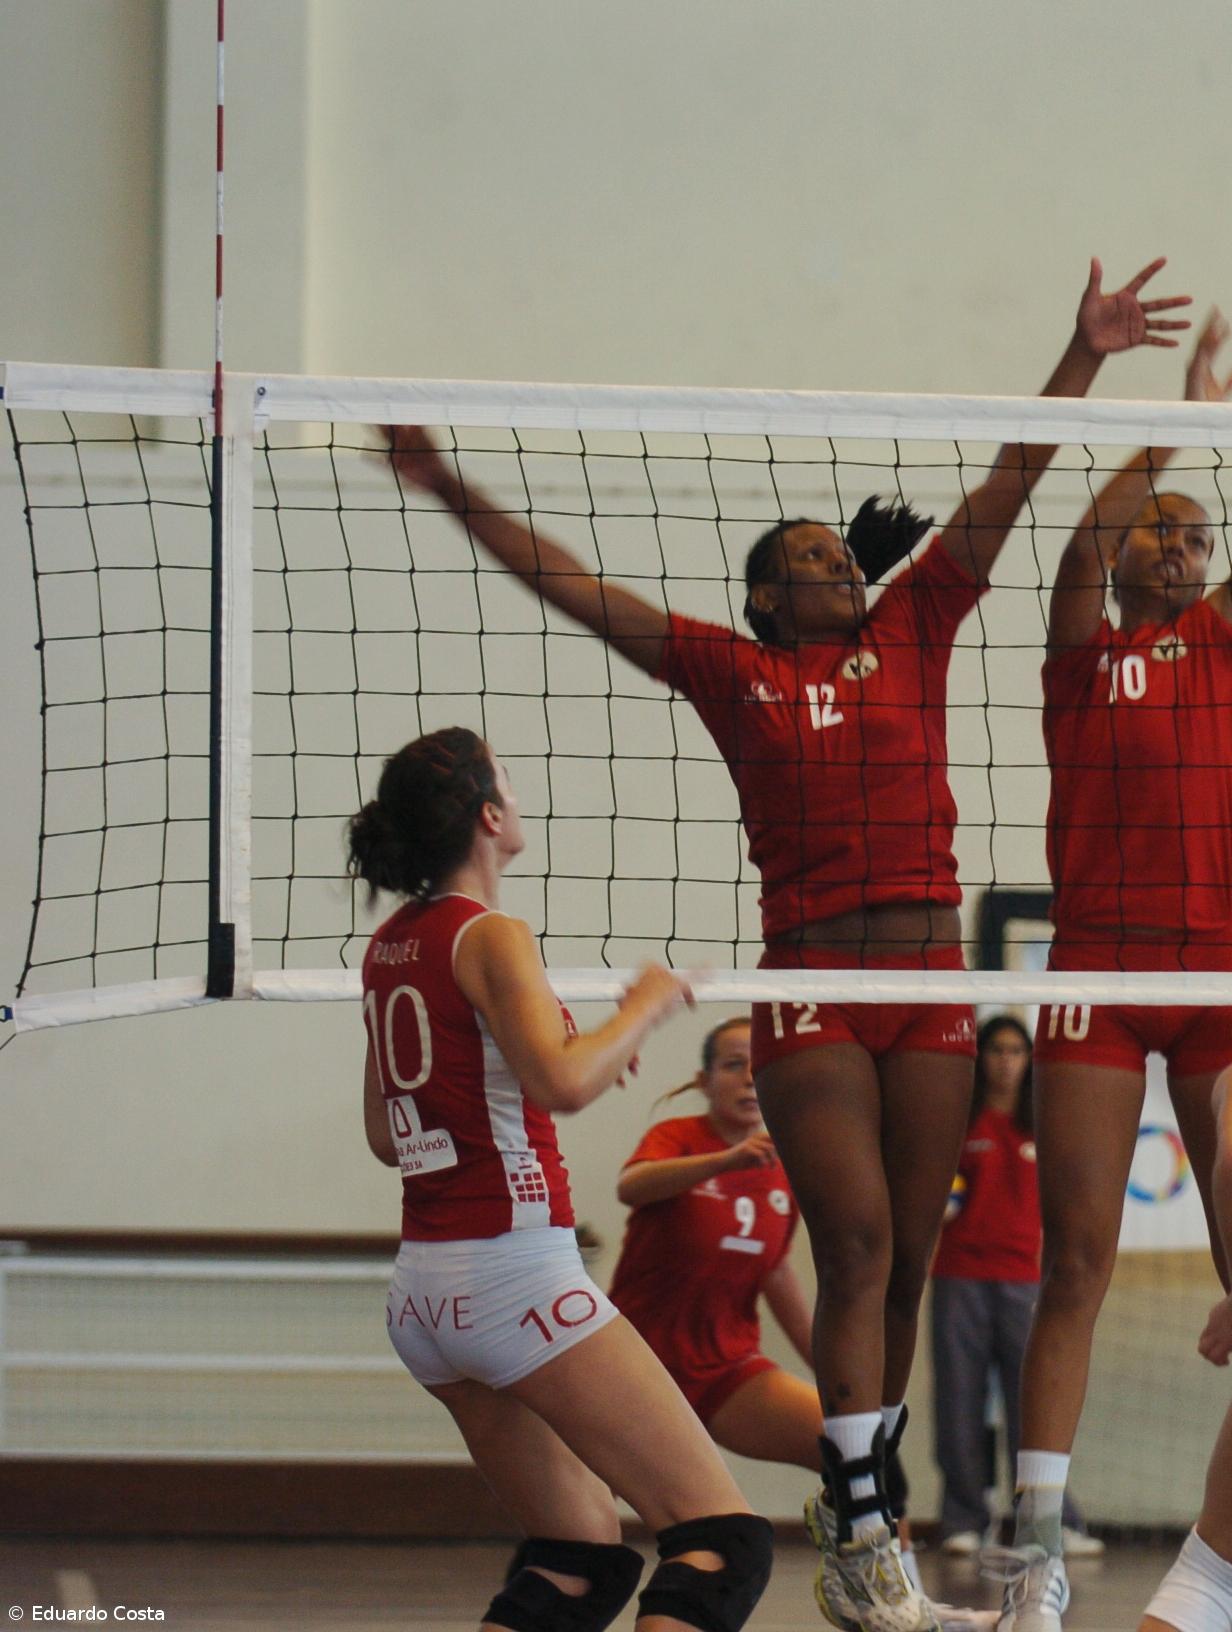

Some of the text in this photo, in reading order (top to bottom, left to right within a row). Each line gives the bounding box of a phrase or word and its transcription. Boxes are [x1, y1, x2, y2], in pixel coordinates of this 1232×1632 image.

[1109, 655, 1146, 702] 10
[806, 683, 844, 730] 12
[373, 939, 419, 965] RAQUEL
[362, 985, 432, 1094] 10
[771, 1002, 821, 1039] 12
[1048, 1005, 1091, 1041] 10
[734, 1196, 756, 1238] 9
[520, 1290, 598, 1343] 10
